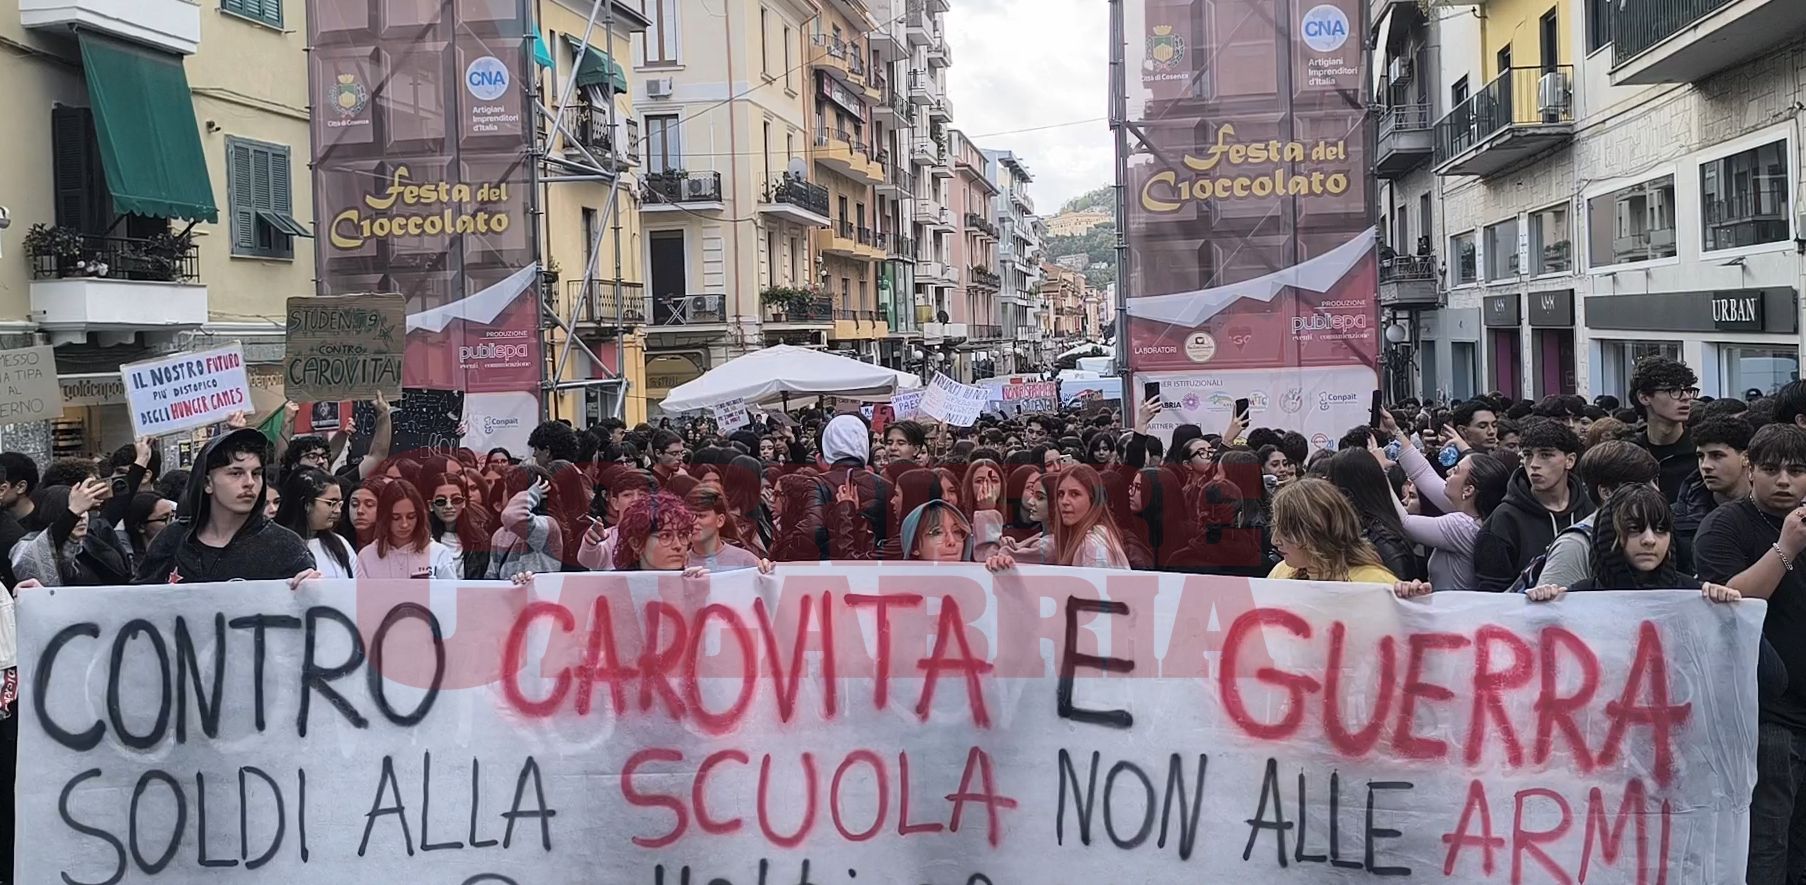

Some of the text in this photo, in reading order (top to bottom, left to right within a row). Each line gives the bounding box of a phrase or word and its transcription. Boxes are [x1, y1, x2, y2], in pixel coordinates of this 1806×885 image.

[1305, 20, 1345, 37] CNA
[1308, 57, 1344, 67] Artigiani
[1308, 66, 1358, 76] Imprenditori
[469, 71, 505, 86] CNA
[1308, 77, 1336, 86] d'Italia
[473, 105, 505, 115] Artigiani
[473, 114, 519, 123] Imprenditori
[1311, 141, 1346, 162] del
[477, 183, 509, 201] del
[1712, 298, 1757, 322] URBAN
[319, 344, 363, 354] CONTRO
[1134, 346, 1177, 355] LABORATORI
[15, 369, 42, 379] TIPA
[133, 353, 240, 389] IL NOSTRO FUTURO
[173, 379, 218, 397] DISTOPICO
[1173, 380, 1223, 388] ISTITUZIONALI
[8, 385, 22, 395] AL
[140, 387, 243, 425] DEGLI HUNGER GAMES
[1160, 401, 1181, 409] ABRIA
[33, 590, 1695, 789] CONTRO CAROVITA E GUERRA
[58, 745, 1672, 885] SOLDI ALLA SCUOLA NON ALLE ARMI
